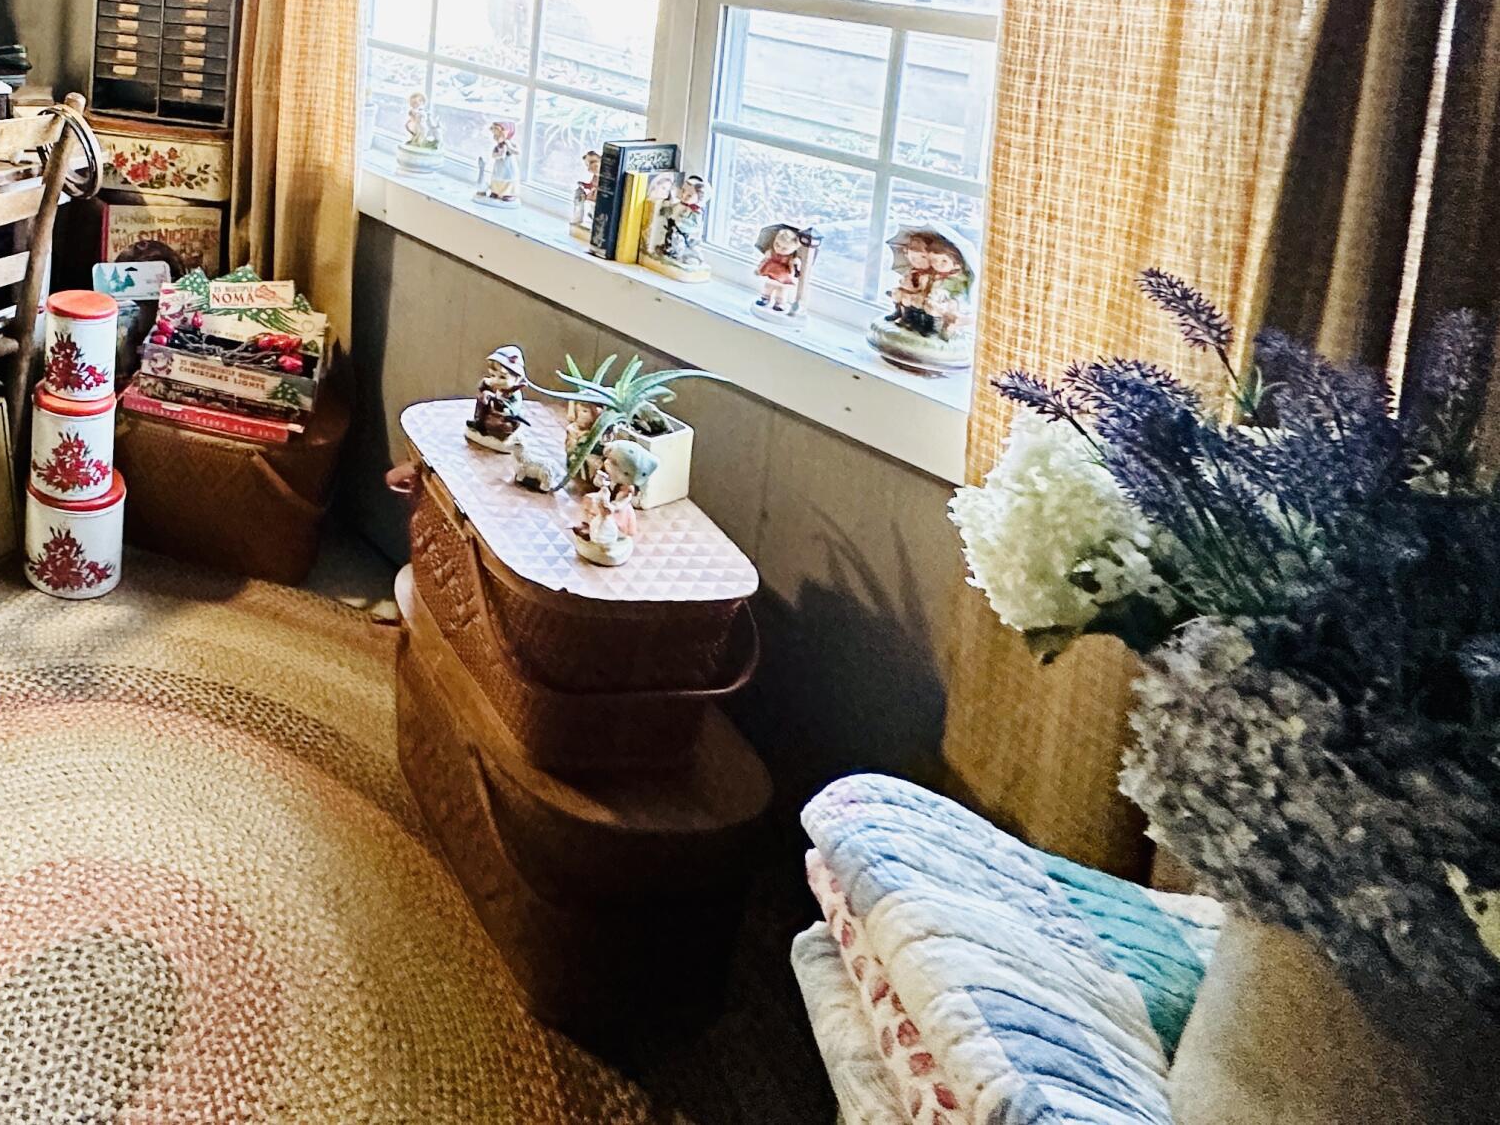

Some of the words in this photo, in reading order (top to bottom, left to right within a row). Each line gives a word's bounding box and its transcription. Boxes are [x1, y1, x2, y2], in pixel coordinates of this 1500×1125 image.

[212, 292, 255, 304] NOMA
[179, 365, 229, 382] CHRISTMAS
[233, 377, 266, 390] LIGHTS
